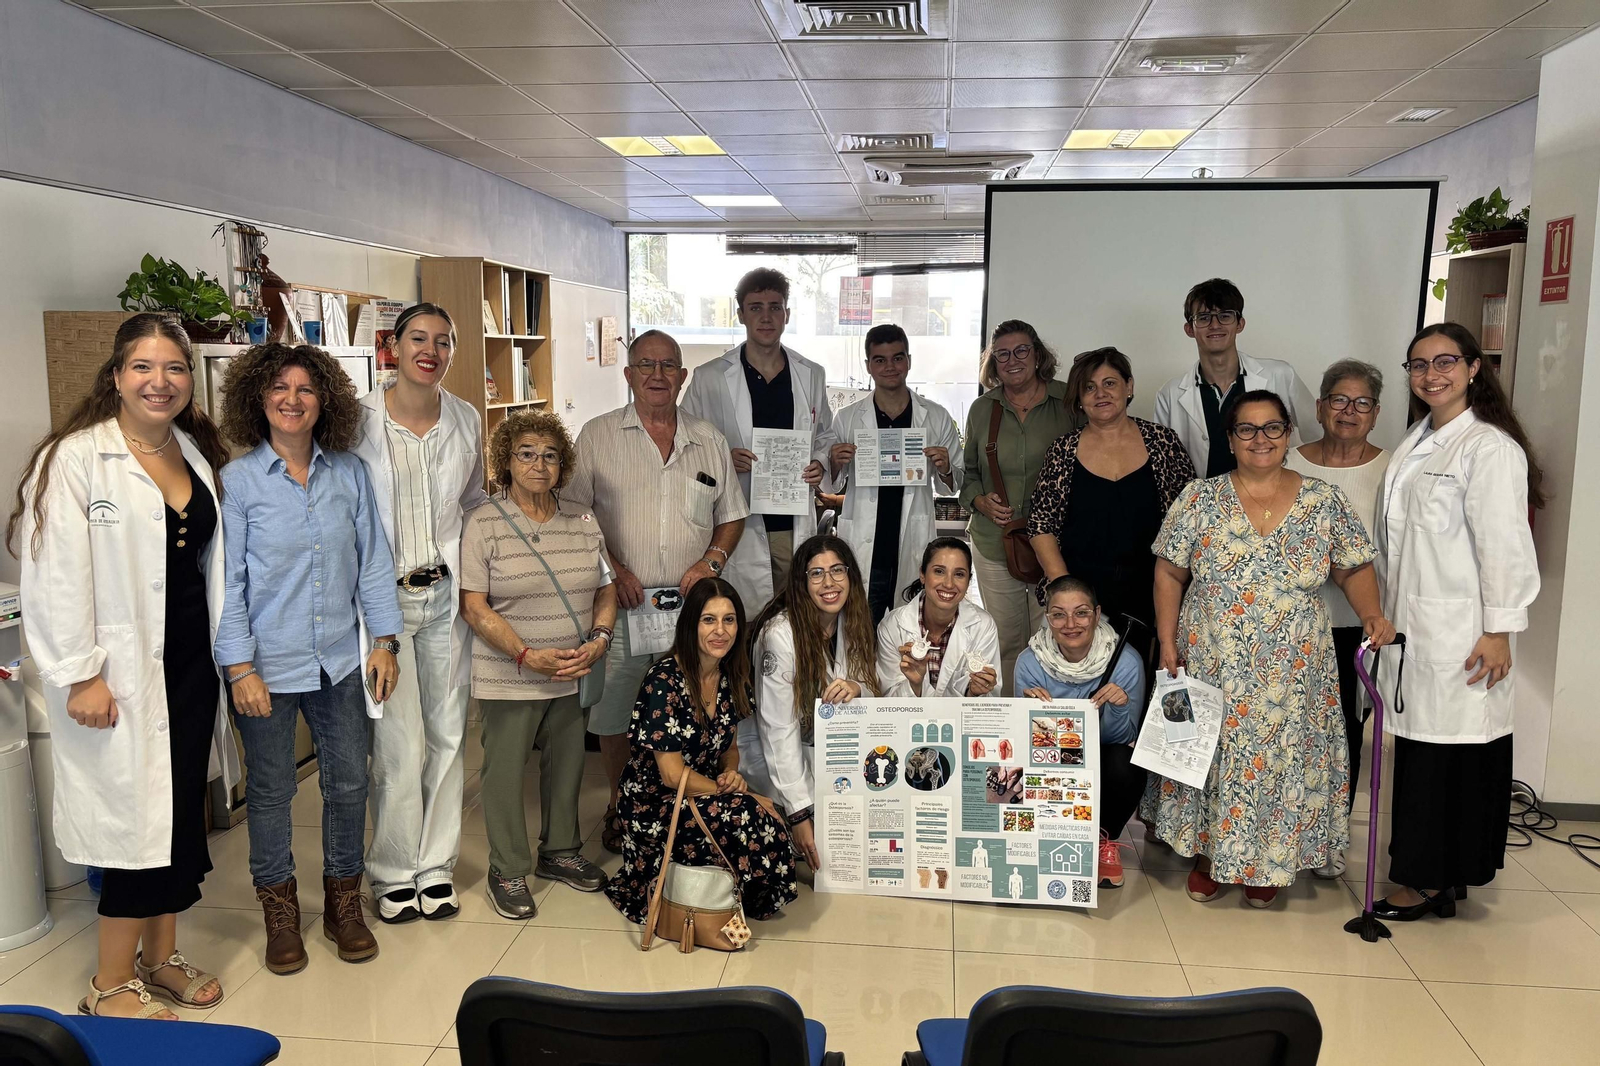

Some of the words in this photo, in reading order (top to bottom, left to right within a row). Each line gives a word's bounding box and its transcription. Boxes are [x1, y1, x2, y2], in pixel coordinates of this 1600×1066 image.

[1544, 286, 1566, 294] EXTINTOR
[1008, 850, 1037, 858] MODIFICABLES
[961, 873, 981, 881] FACTORES
